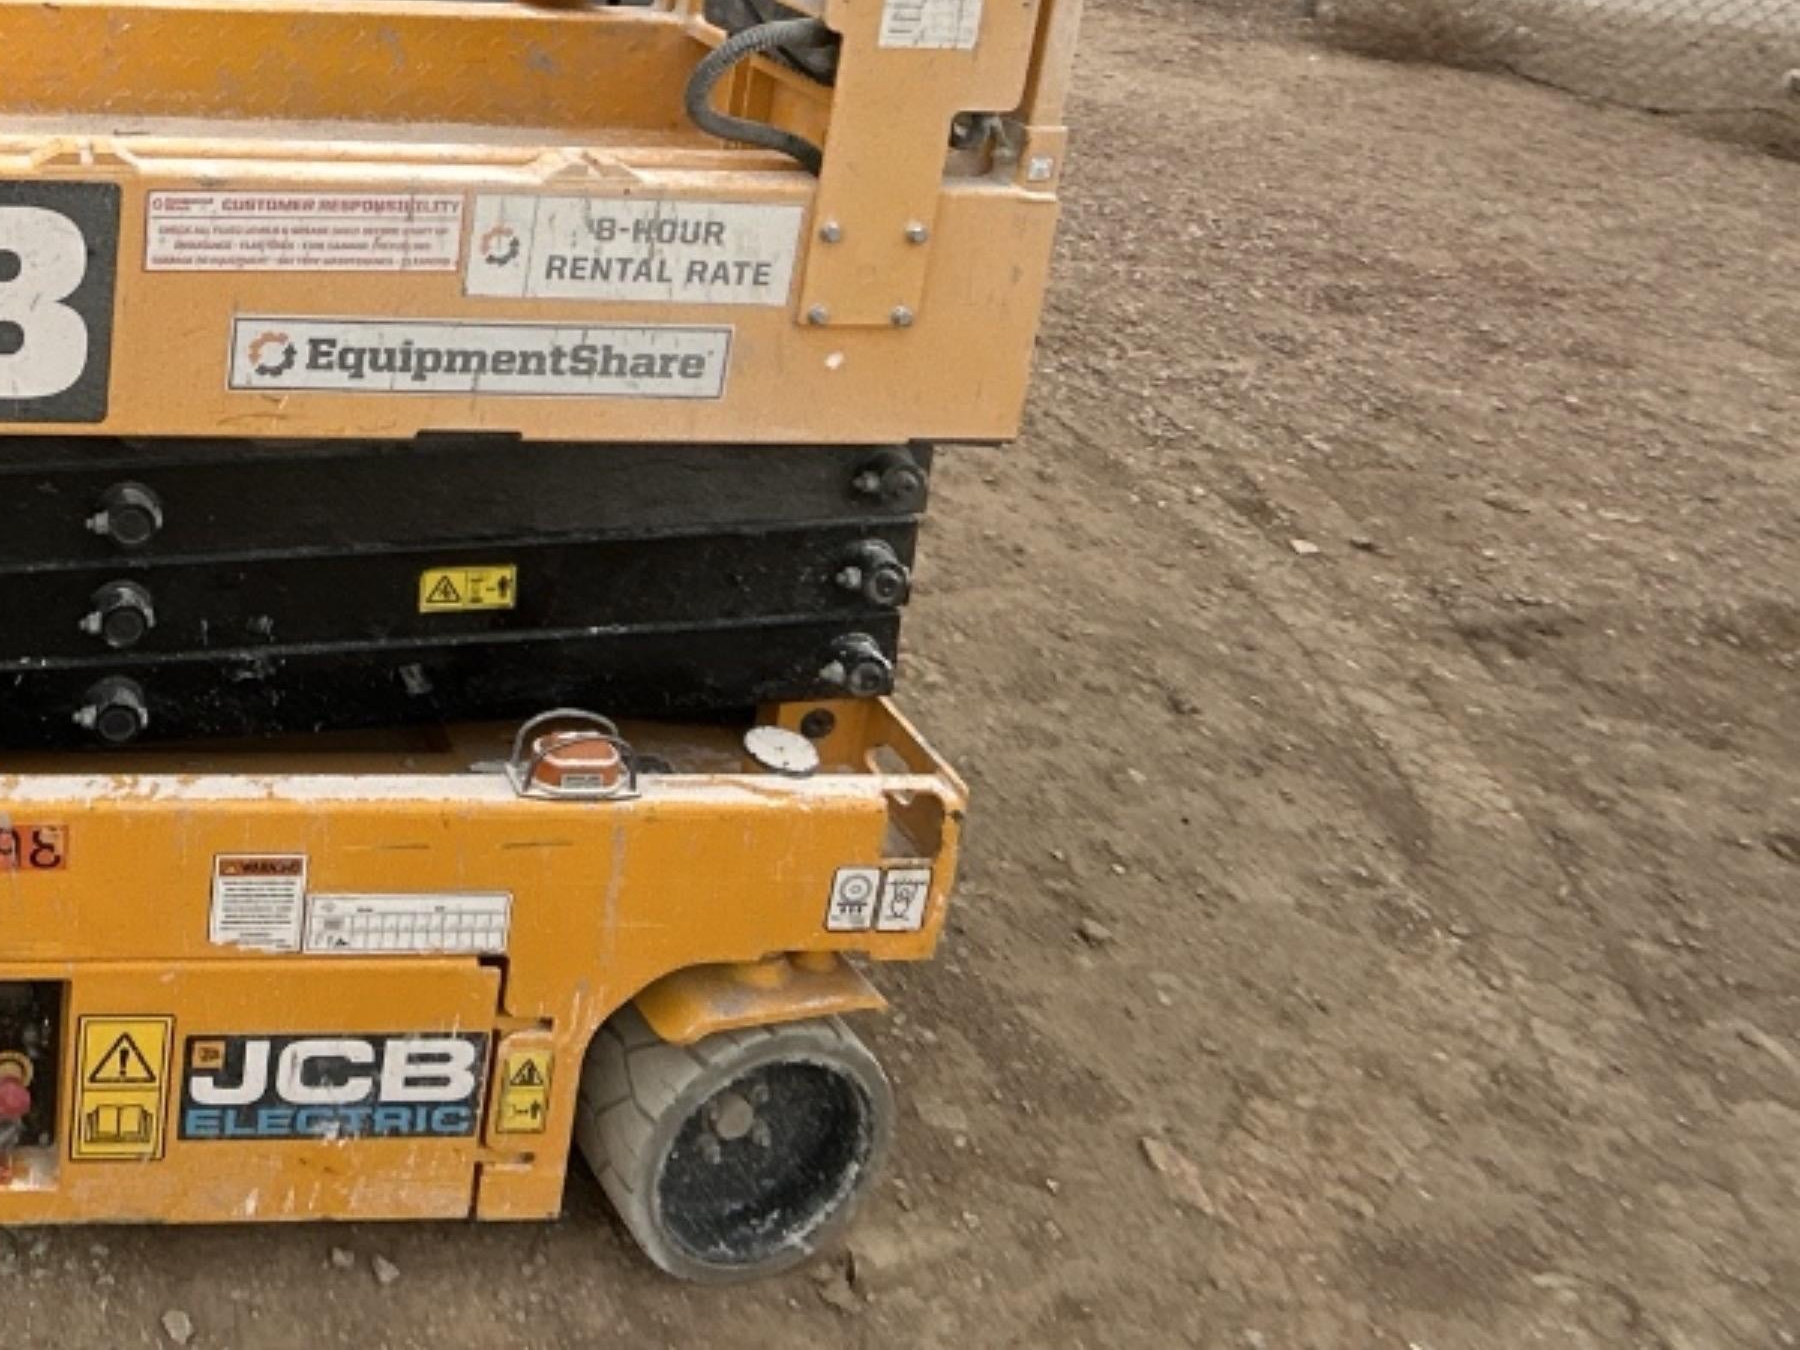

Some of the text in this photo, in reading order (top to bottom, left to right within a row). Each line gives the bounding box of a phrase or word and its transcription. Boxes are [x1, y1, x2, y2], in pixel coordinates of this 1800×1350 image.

[221, 197, 317, 212] CUSTOMER
[593, 217, 726, 246] 8-HOUR
[544, 254, 773, 287] RENTAL RATE
[305, 337, 706, 381] EquipmentShare
[188, 1039, 476, 1105] JCB
[184, 1104, 471, 1136] ELECTRIC
